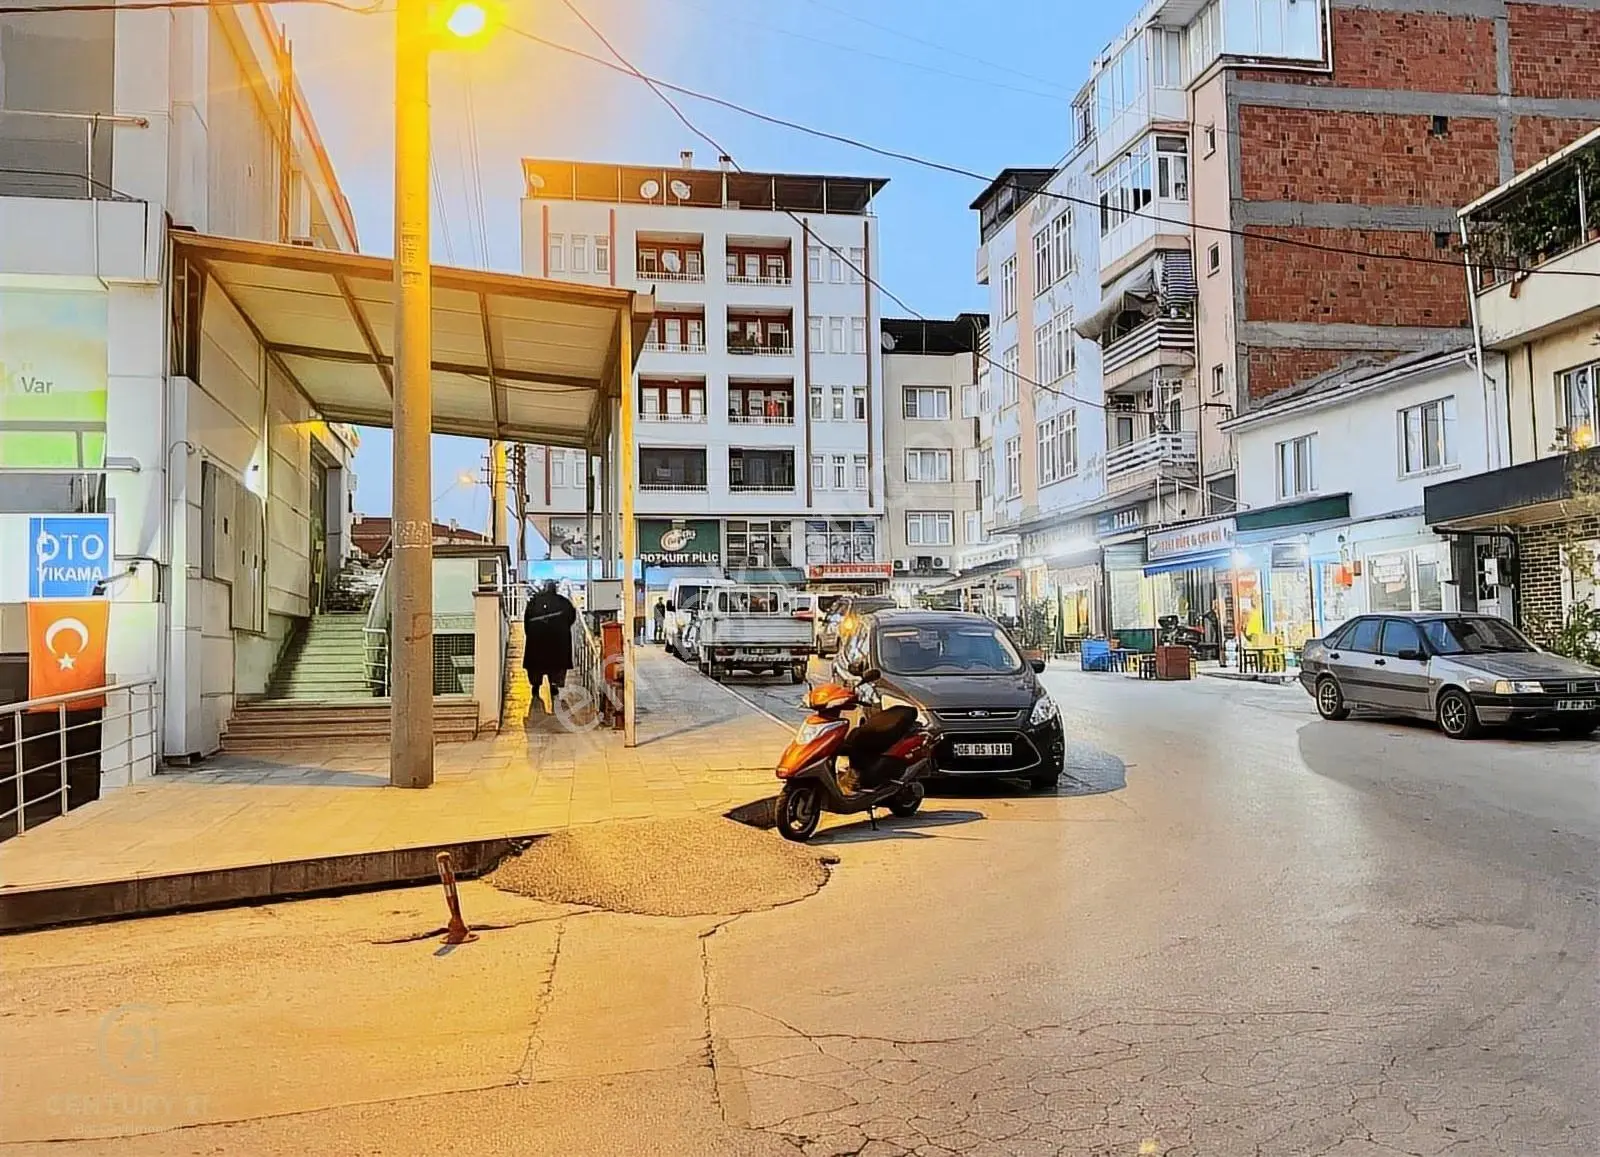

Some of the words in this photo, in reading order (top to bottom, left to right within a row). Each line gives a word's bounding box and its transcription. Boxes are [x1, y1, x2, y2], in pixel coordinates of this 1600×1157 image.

[20, 376, 54, 395] Var
[36, 532, 105, 561] OTO
[36, 567, 104, 582] YIKAMA
